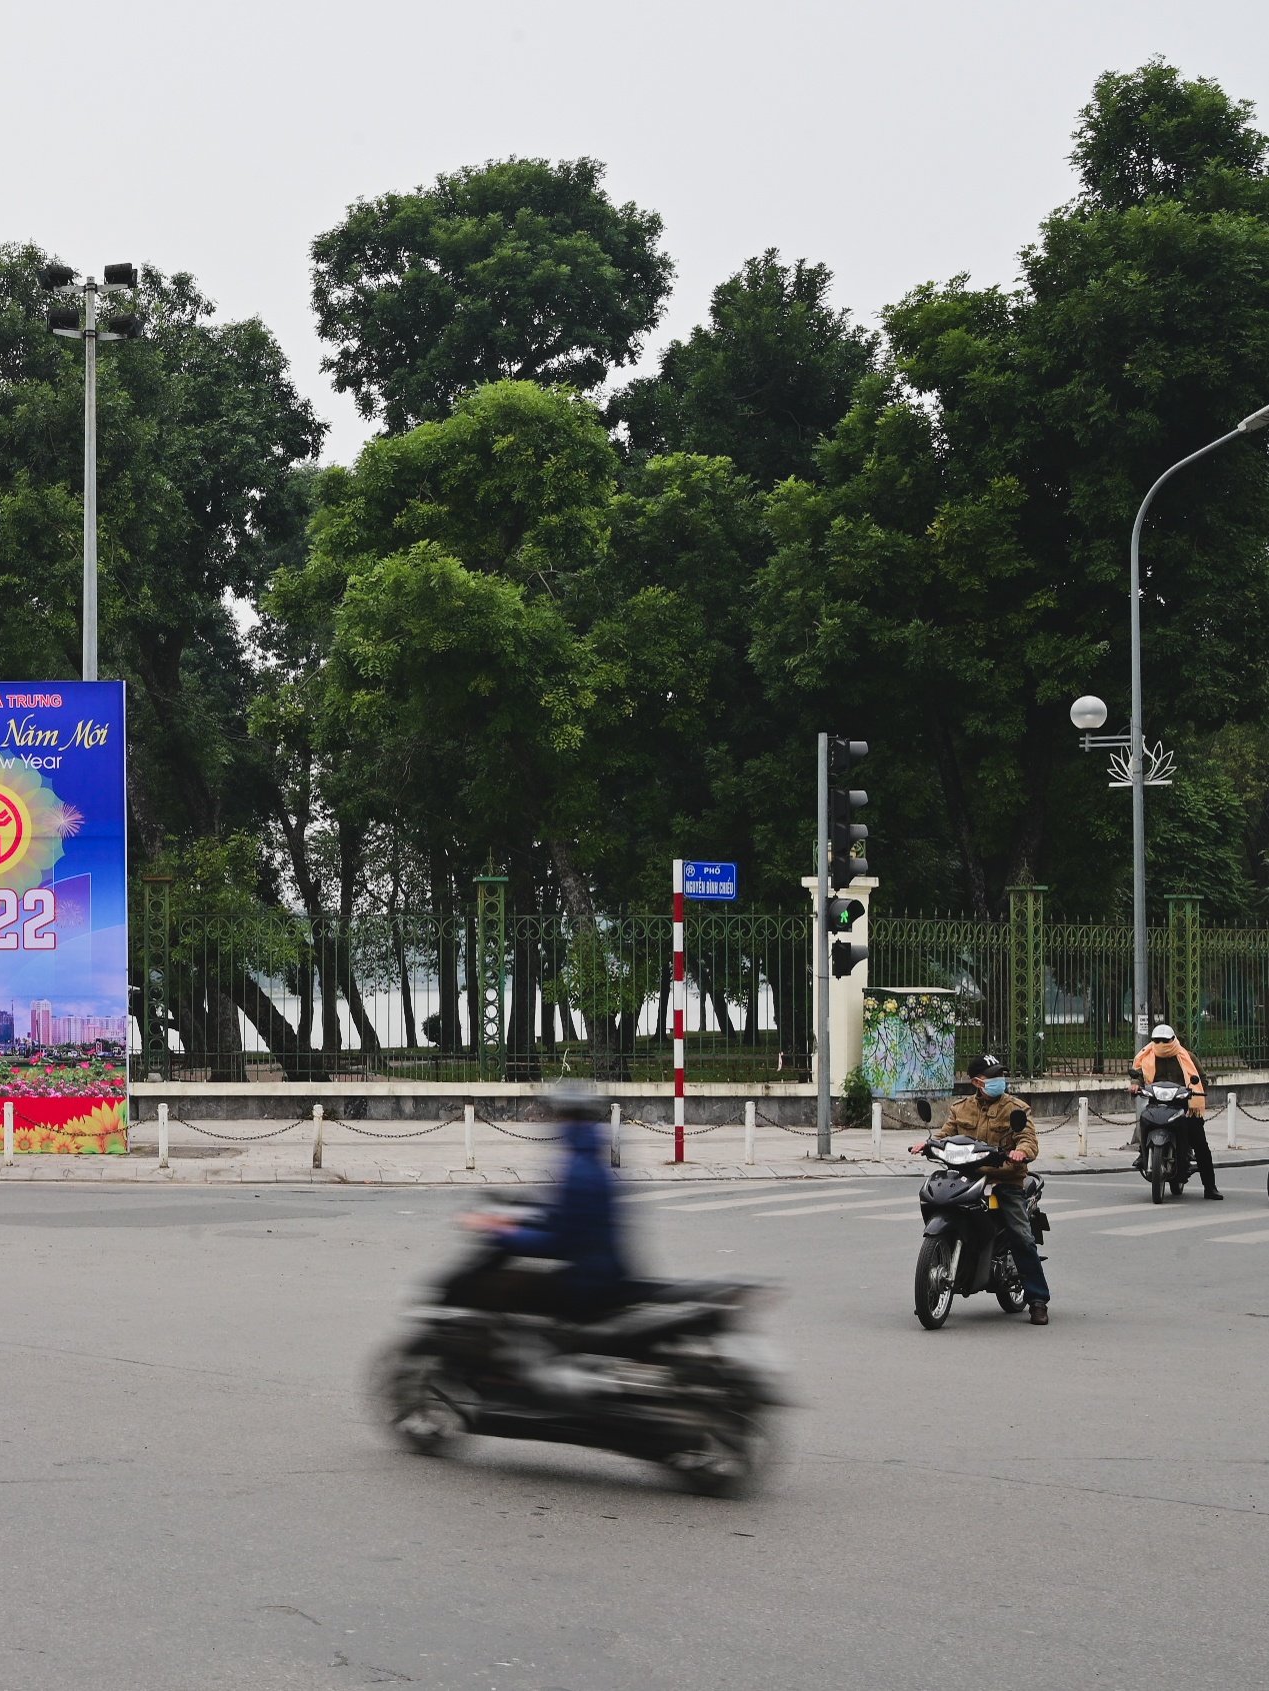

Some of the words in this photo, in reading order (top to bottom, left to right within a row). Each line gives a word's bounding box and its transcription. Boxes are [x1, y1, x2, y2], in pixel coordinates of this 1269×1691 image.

[6, 694, 63, 709] TRƯNG
[0, 713, 58, 748] Năm
[58, 718, 110, 752] Mới
[20, 753, 63, 770] Year
[704, 864, 721, 875] PHỐ
